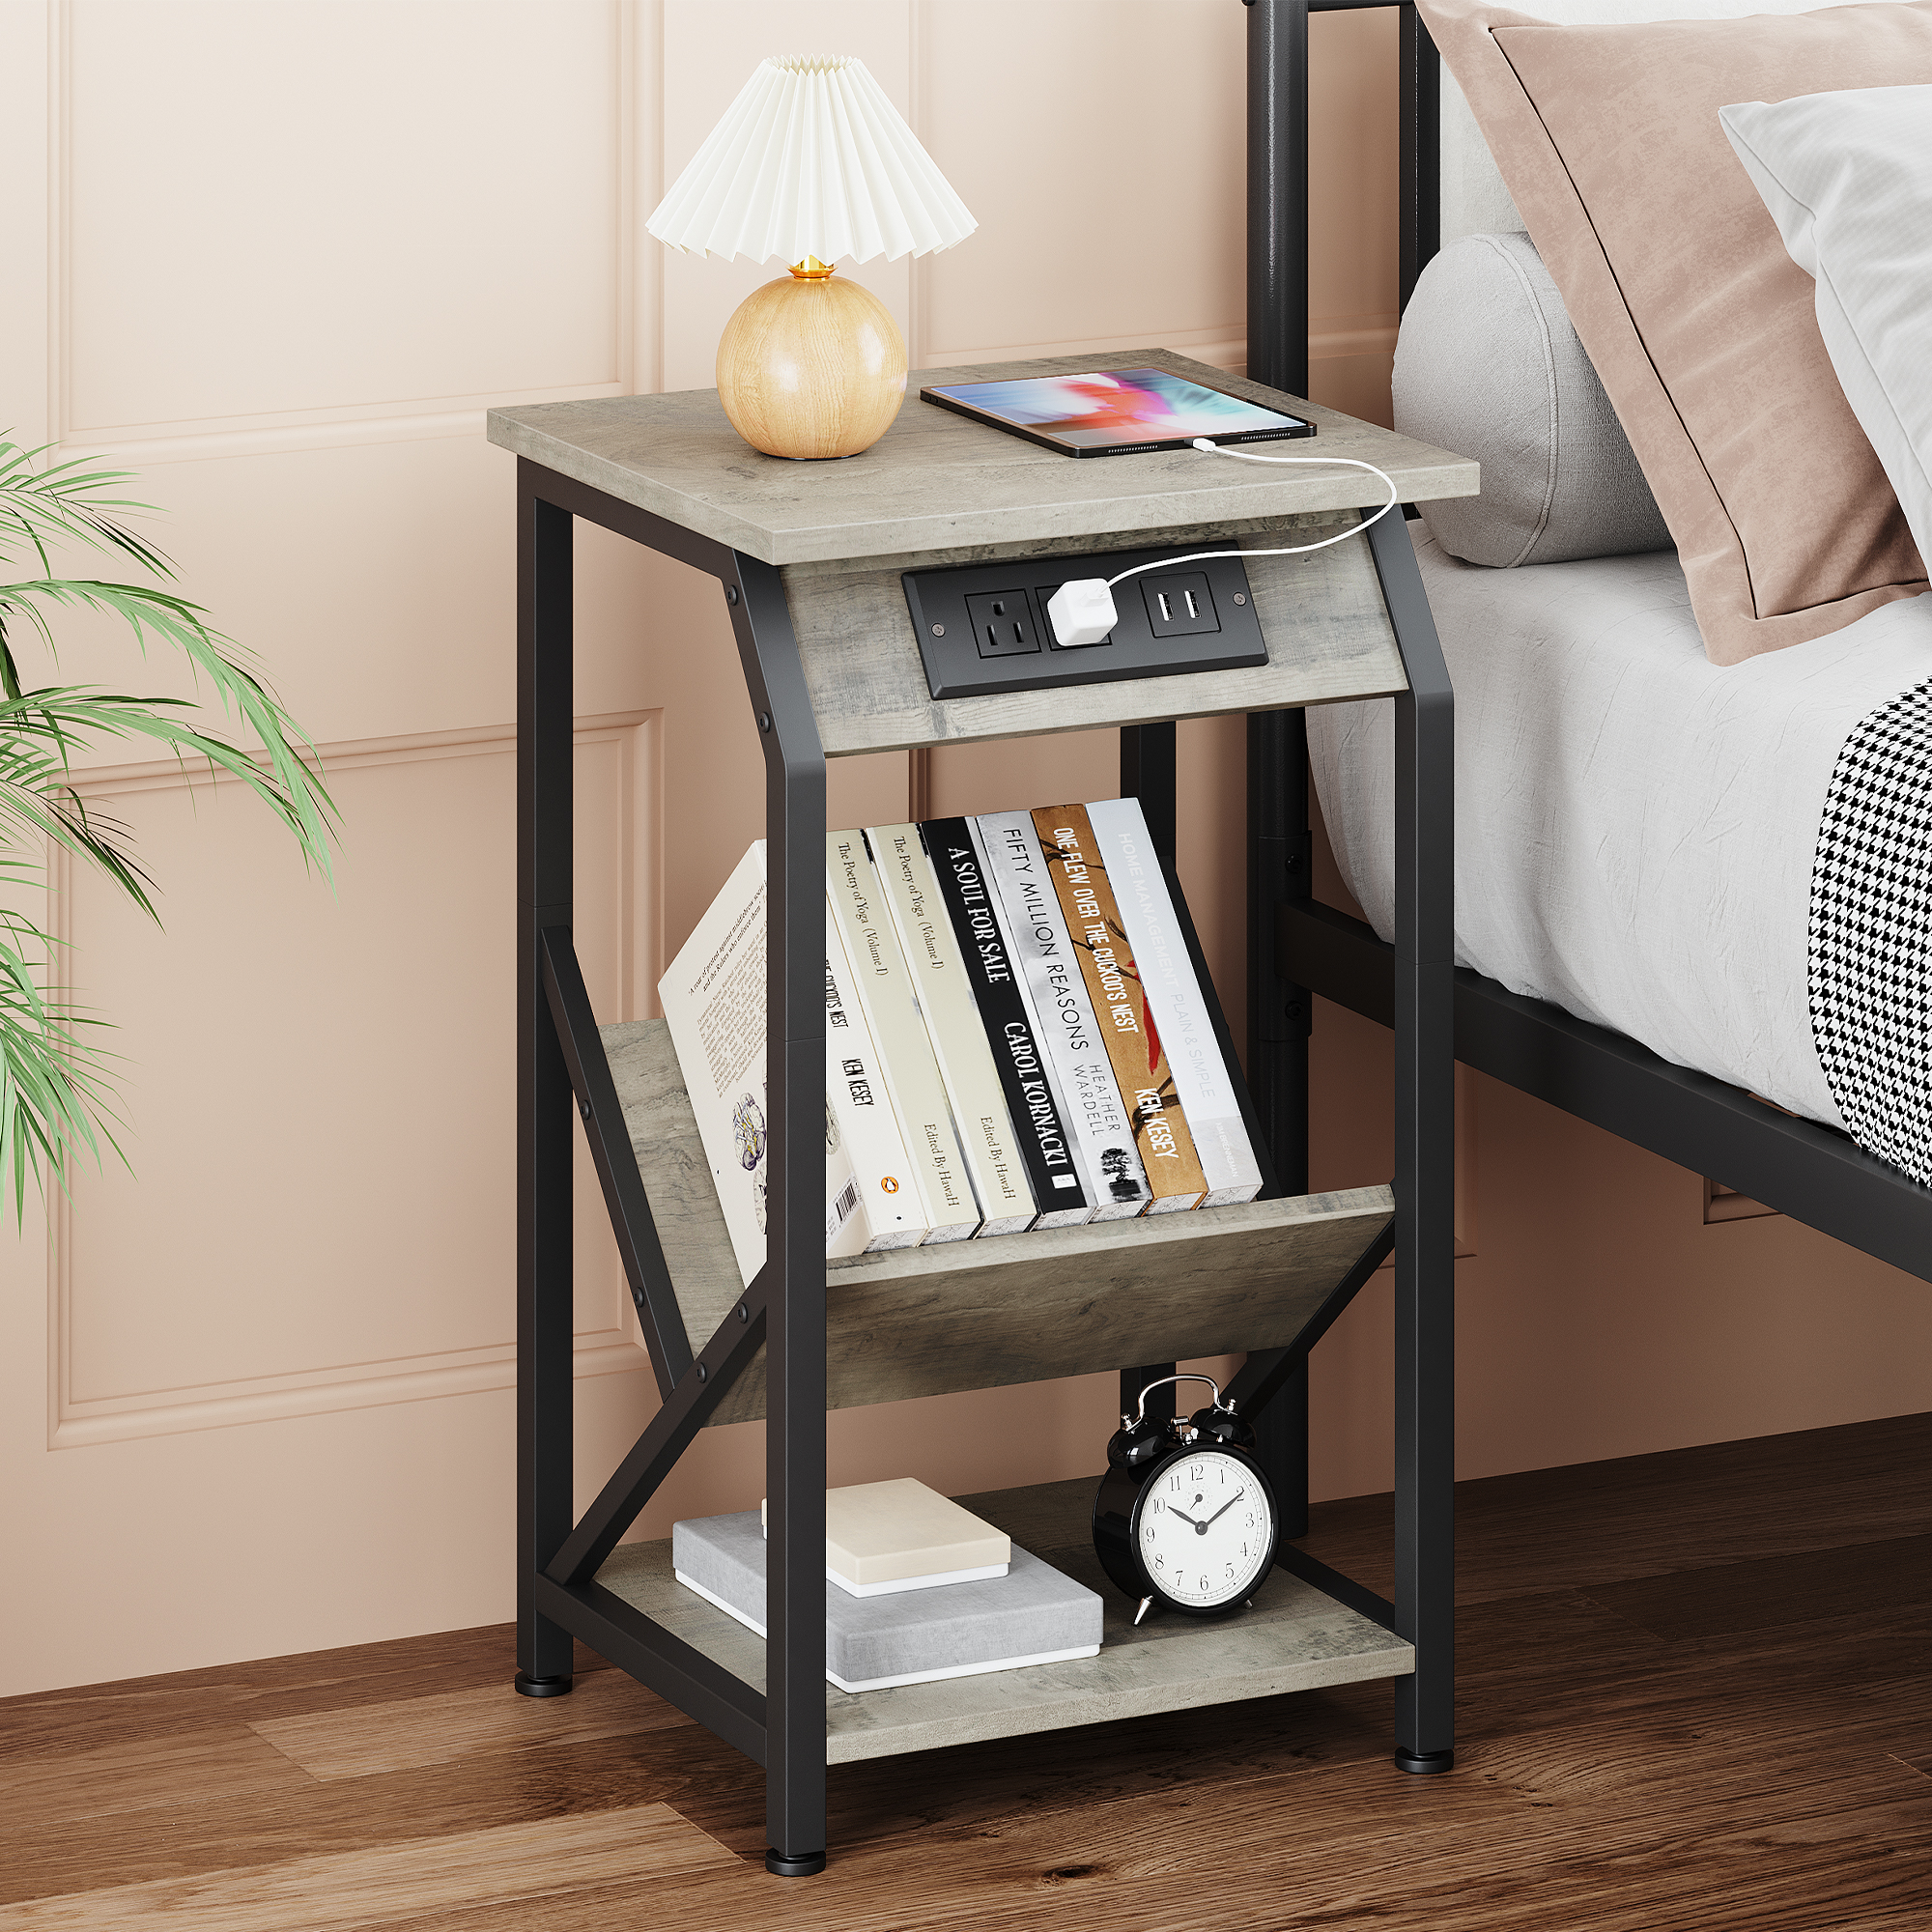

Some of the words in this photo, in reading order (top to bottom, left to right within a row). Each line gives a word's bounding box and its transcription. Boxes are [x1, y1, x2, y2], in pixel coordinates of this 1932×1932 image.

[838, 842, 850, 859] The
[894, 836, 906, 853] The
[1053, 827, 1079, 850] ONE
[948, 847, 970, 860] A
[1118, 833, 1144, 877] HOME
[843, 862, 858, 889] Poetry
[899, 855, 914, 882] Poetry
[1061, 852, 1091, 884] FLEW
[853, 892, 867, 901] of
[908, 884, 922, 895] of
[952, 862, 984, 905] SOUL
[856, 901, 868, 923] Yoga
[911, 895, 924, 917] Yoga
[1072, 888, 1100, 919] OVER
[967, 907, 997, 941] FOR
[1084, 921, 1110, 945] THE
[1132, 874, 1179, 987] MANAGEMENT
[863, 928, 881, 966] (Volume
[918, 922, 937, 959] (Volume
[1003, 829, 1034, 873] FIFTY
[1019, 882, 1060, 956] MILLION
[1046, 964, 1089, 1050] REASONS
[978, 943, 1010, 983] SALE
[1092, 947, 1127, 1002] CUCKOO'S
[829, 1010, 848, 1028] NEST
[1110, 1003, 1139, 1033] NEST
[1171, 993, 1195, 1033] PLAIN
[1004, 1022, 1040, 1078] CAROL
[1184, 1037, 1198, 1046] &
[841, 1058, 866, 1077] KEN
[1188, 1049, 1216, 1098] SIMPLE
[848, 1079, 874, 1107] KESEY
[1072, 1064, 1105, 1136] WARDELL
[1089, 1064, 1121, 1132] HEATHER
[1134, 1087, 1164, 1115] KEN
[980, 1117, 1000, 1147] Edited
[1021, 1079, 1068, 1167] KORNACKI
[924, 1123, 943, 1153] Edited
[1144, 1117, 1179, 1159] KESEY
[932, 1156, 946, 1169] By
[988, 1149, 1003, 1161] By
[939, 1171, 959, 1207] HawaH
[995, 1163, 1016, 1199] HawaH
[1170, 1475, 1181, 1492] 11
[1190, 1463, 1205, 1481] 12
[1153, 1497, 1166, 1514] 10
[1236, 1486, 1245, 1502] 2
[1245, 1512, 1255, 1528] 3
[1146, 1526, 1155, 1543] 9
[1154, 1553, 1164, 1570] 8
[1239, 1542, 1248, 1557] 4
[1176, 1570, 1183, 1586] 7
[1200, 1575, 1208, 1591] 6
[1225, 1563, 1235, 1578] 5
